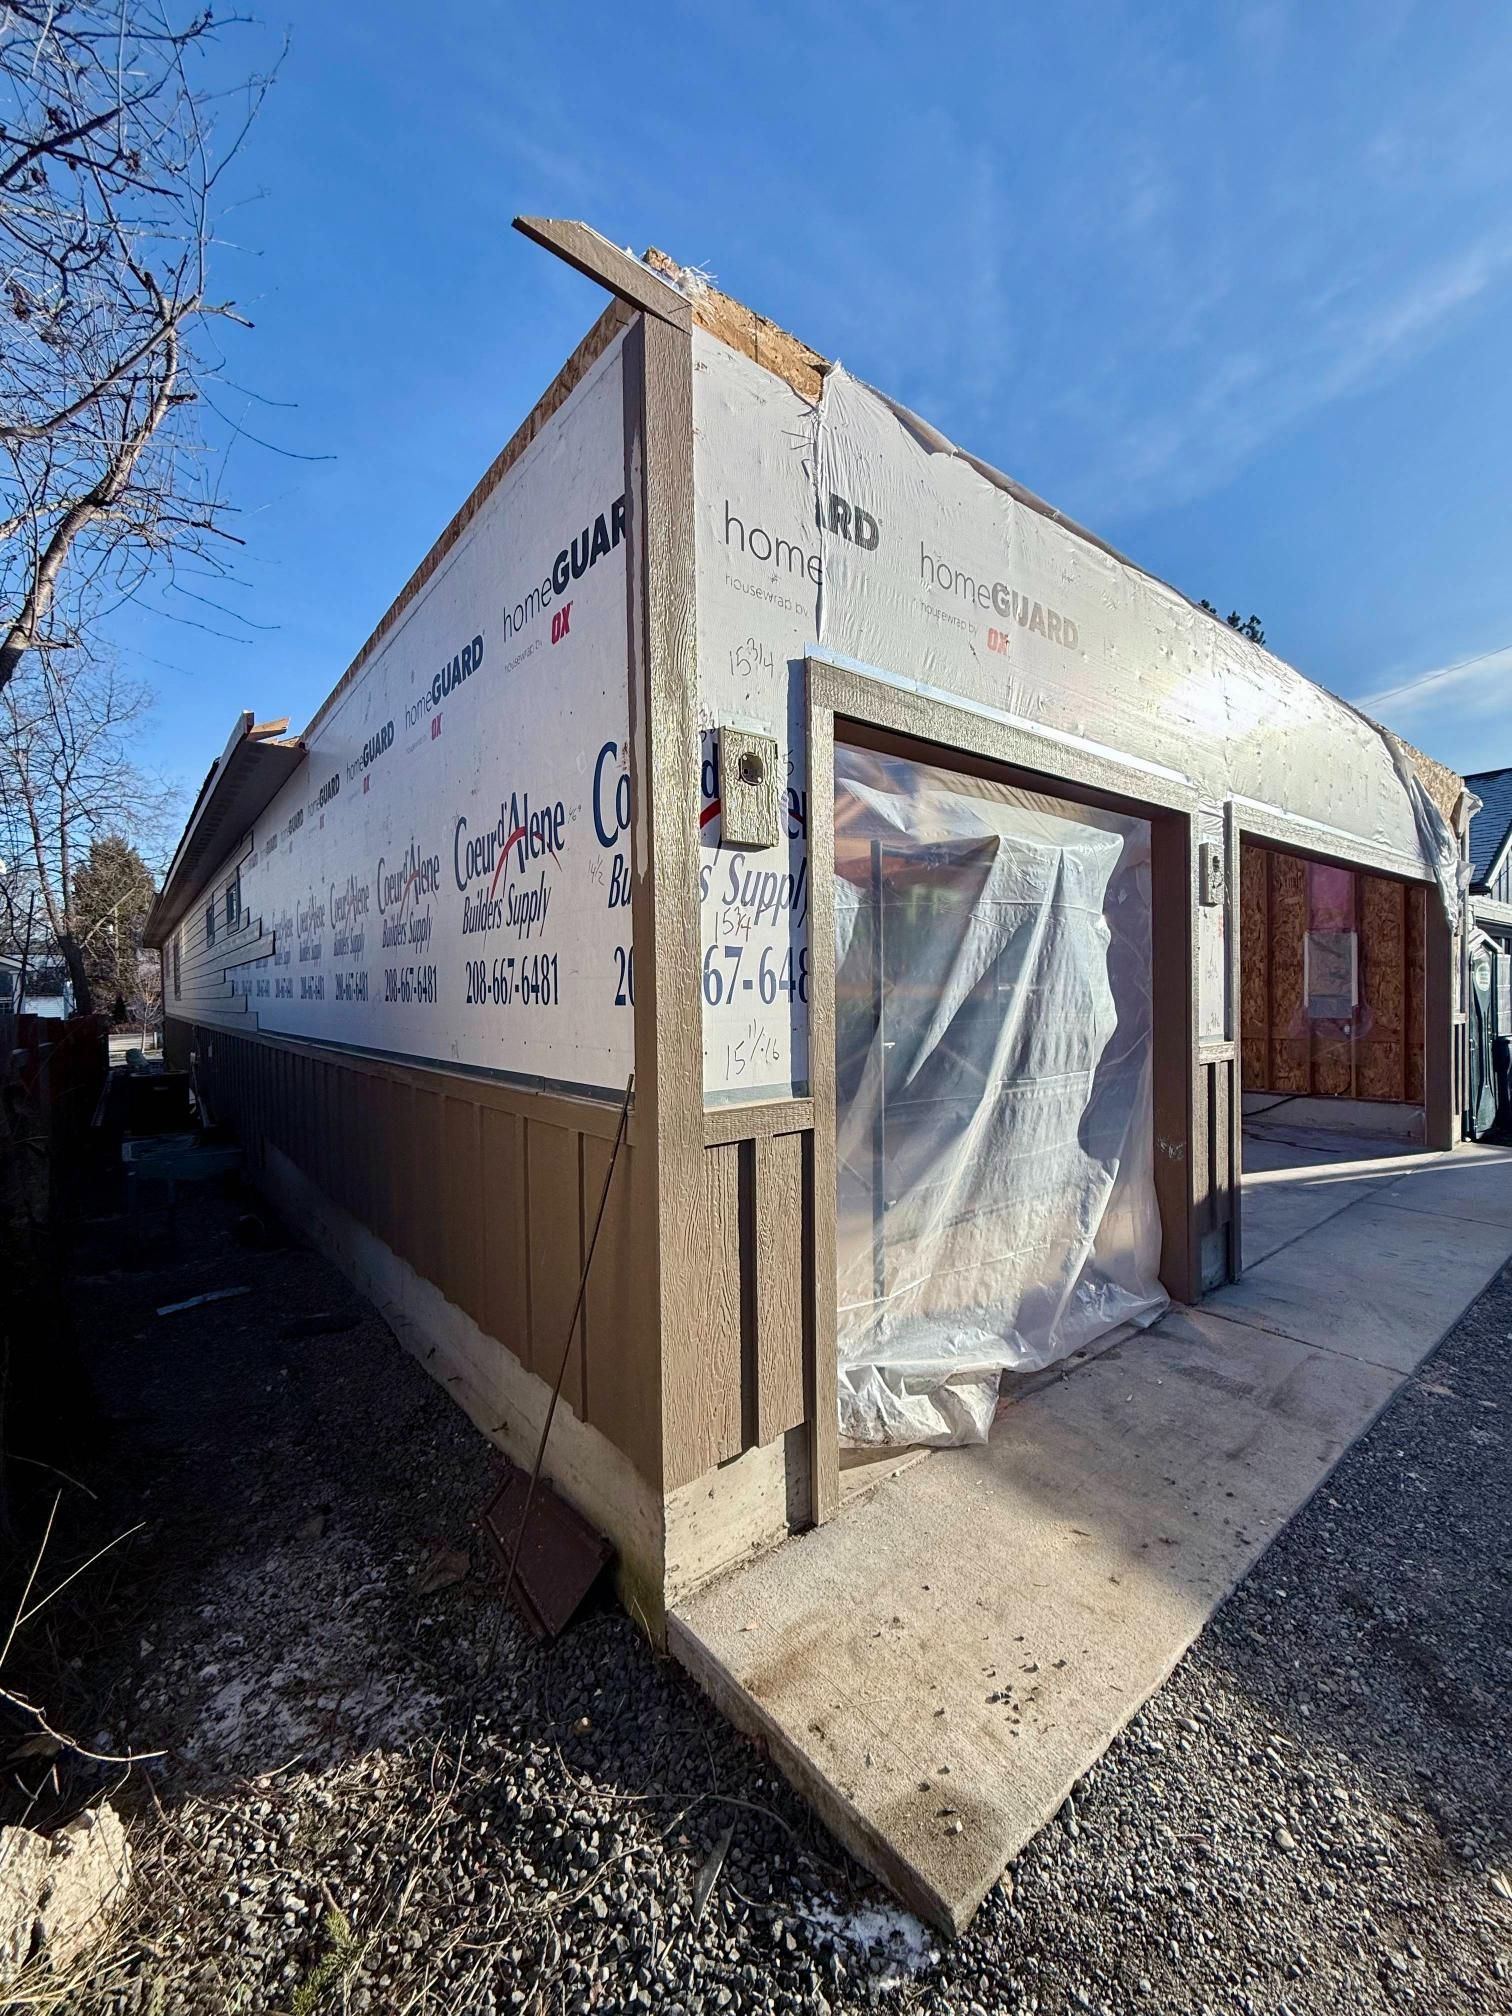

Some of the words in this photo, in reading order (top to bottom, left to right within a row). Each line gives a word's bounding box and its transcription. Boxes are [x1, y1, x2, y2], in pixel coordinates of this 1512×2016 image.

[921, 541, 1079, 650] homeGUARD
[405, 634, 485, 731] homeGUARD
[377, 857, 403, 915] Coeur
[454, 817, 496, 892] Coeur
[409, 904, 432, 954] Supply
[463, 887, 502, 934] Builders
[506, 871, 551, 940] Supply
[466, 952, 558, 1005] 208-667-6481
